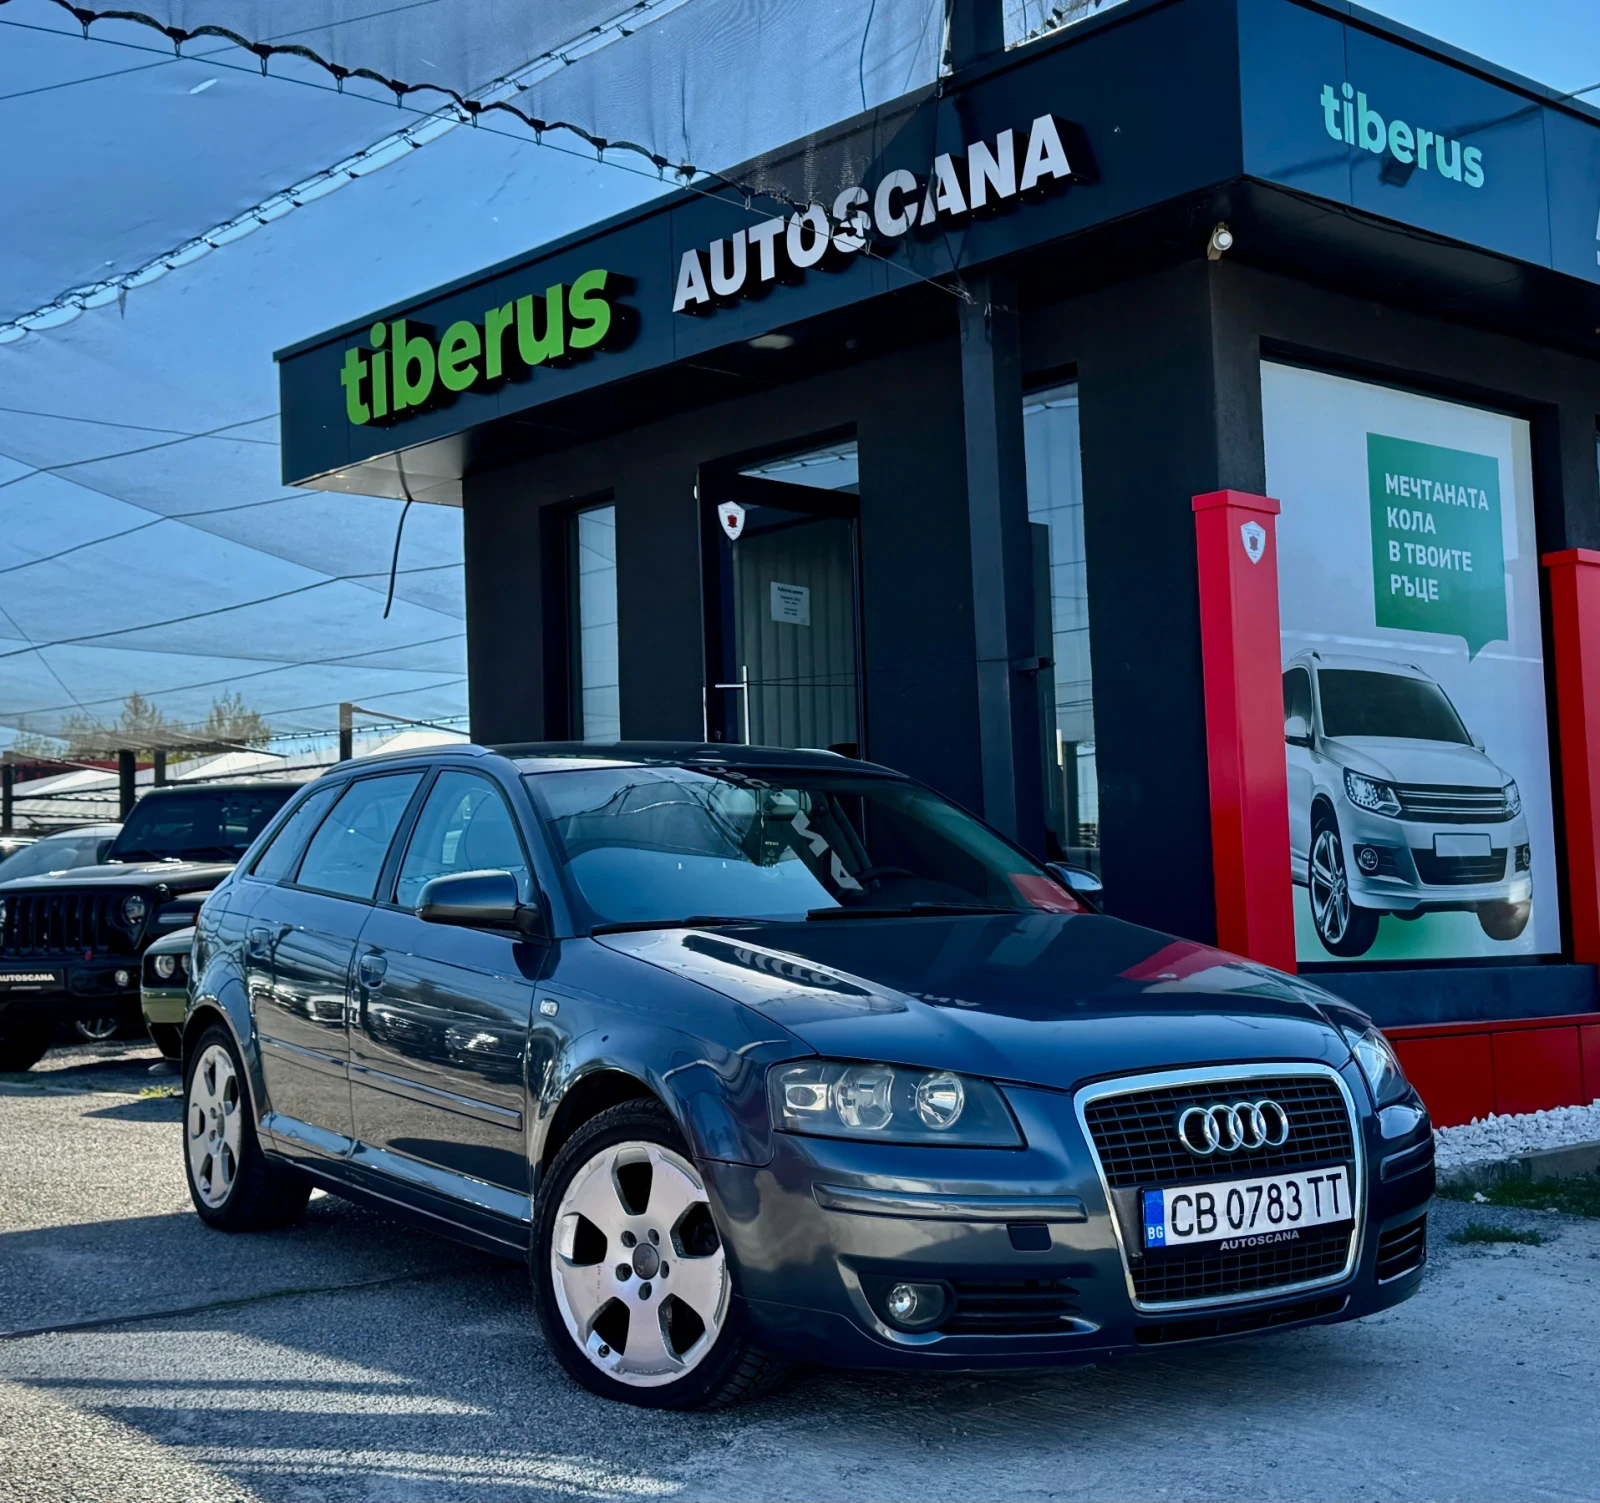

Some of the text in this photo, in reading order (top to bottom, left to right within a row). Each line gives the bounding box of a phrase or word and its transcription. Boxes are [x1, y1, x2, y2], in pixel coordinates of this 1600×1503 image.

[1320, 82, 1485, 188] tiberus
[672, 113, 1072, 313] AUTOSCANA
[340, 268, 612, 426] tiberus
[1385, 473, 1489, 511] МЕЧТАНАТА
[1387, 507, 1436, 534] КОЛА
[1389, 540, 1472, 572] В ТВОИТЕ
[1391, 574, 1439, 602] РЪЦЕ
[1171, 1172, 1342, 1237] CB 0783 TT
[1148, 1226, 1163, 1240] BG
[1220, 1230, 1300, 1251] AUTOSCANA
